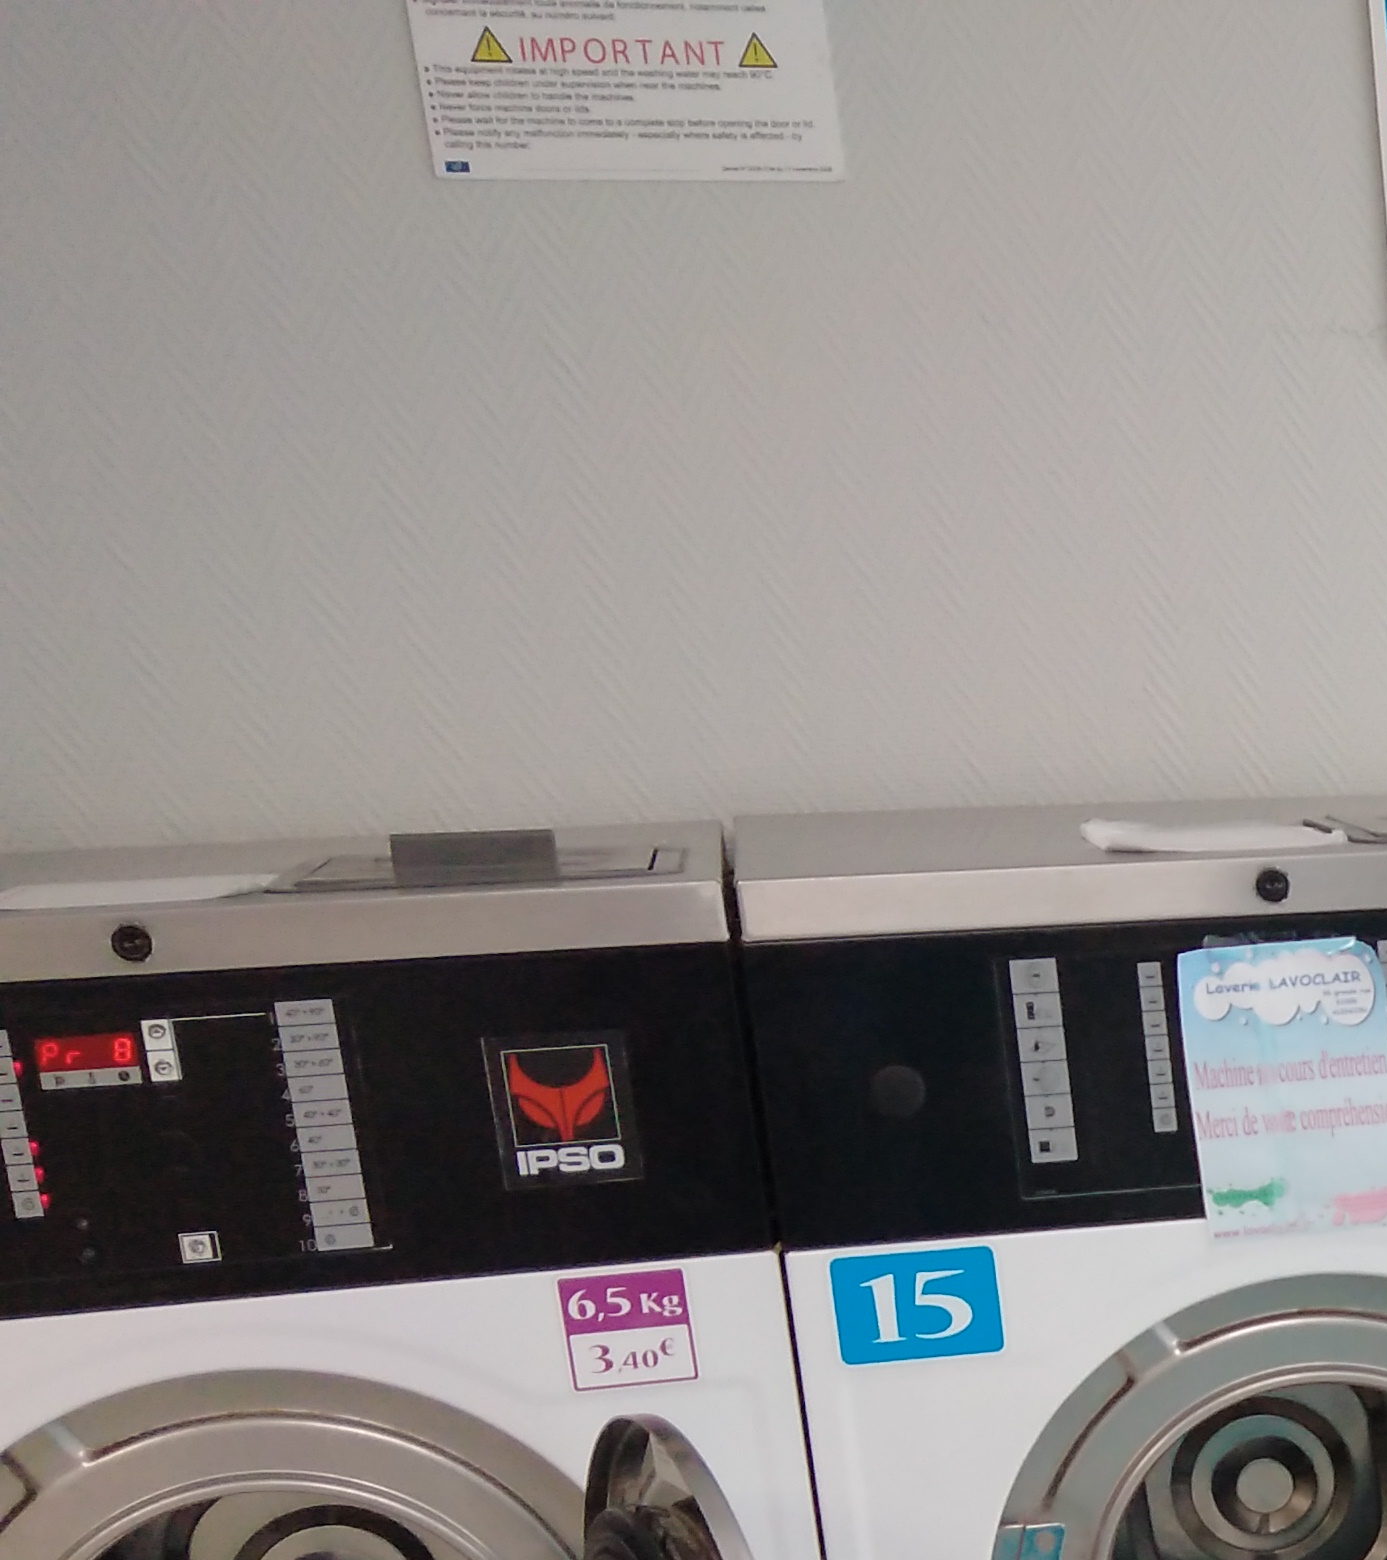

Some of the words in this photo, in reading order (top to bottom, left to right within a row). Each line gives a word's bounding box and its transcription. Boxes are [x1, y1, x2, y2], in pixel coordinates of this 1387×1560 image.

[518, 36, 725, 66] IMPORTANT
[1269, 970, 1362, 989] LAVOCLAIR
[113, 1037, 132, 1062] 8
[1193, 1059, 1254, 1090] Machine
[1279, 1060, 1315, 1082] cours
[1196, 1110, 1239, 1140] Merci
[1242, 1106, 1259, 1135] de
[516, 1144, 625, 1177] IPSO
[567, 1287, 632, 1322] 6,5
[639, 1292, 683, 1317] Kg
[859, 1269, 974, 1343] 15
[589, 1337, 676, 1374] 3,40€
